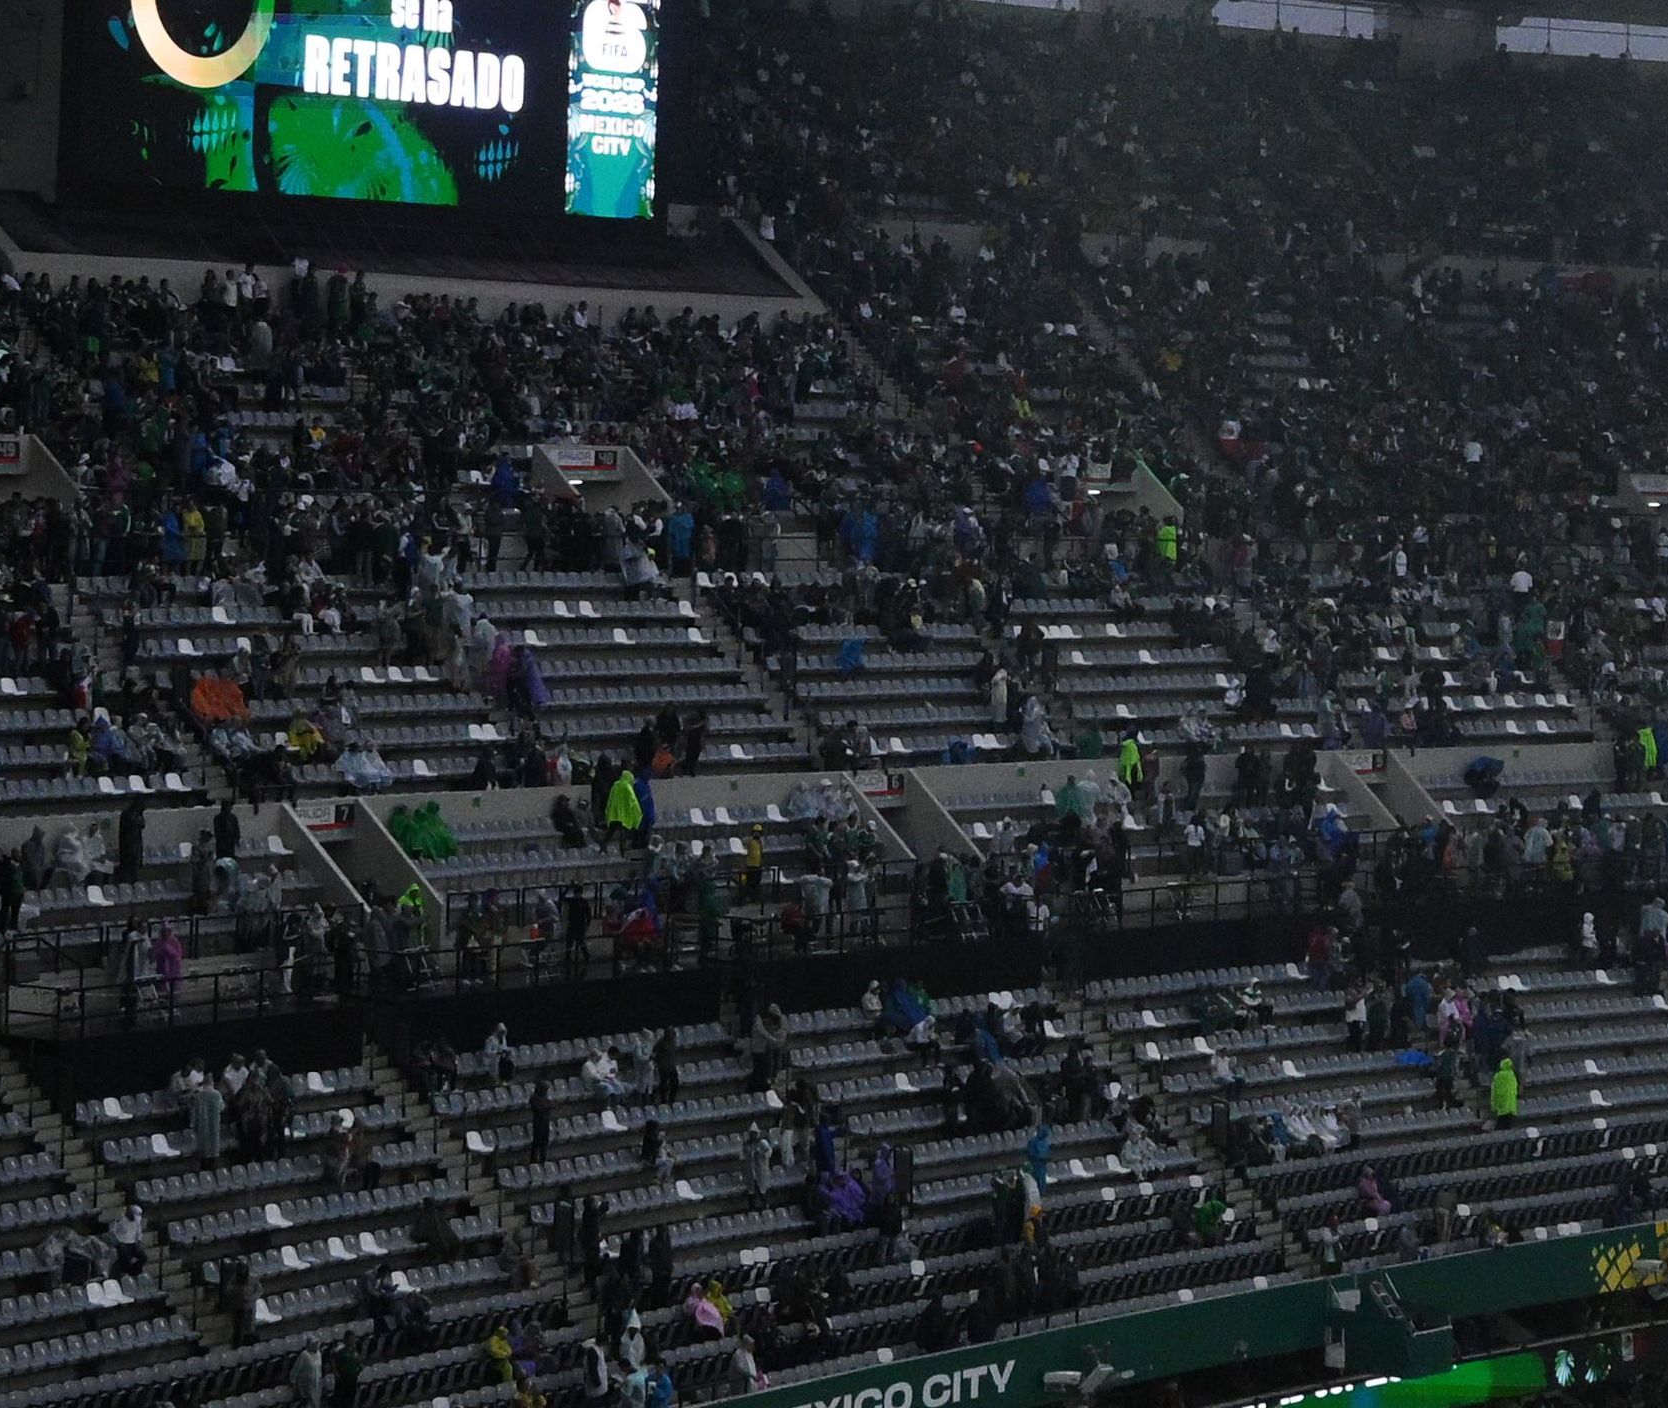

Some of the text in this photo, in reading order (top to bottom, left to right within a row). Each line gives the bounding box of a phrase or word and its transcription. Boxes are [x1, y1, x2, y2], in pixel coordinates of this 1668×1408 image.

[602, 43, 628, 57] FIFA
[303, 34, 525, 113] RETRASADO
[581, 73, 645, 92] WORLD CUP
[580, 88, 645, 115] 2026
[579, 114, 645, 137] MEXICO
[591, 135, 631, 156] CITY
[340, 805, 349, 822] 7
[921, 1359, 1016, 1408] CITY
